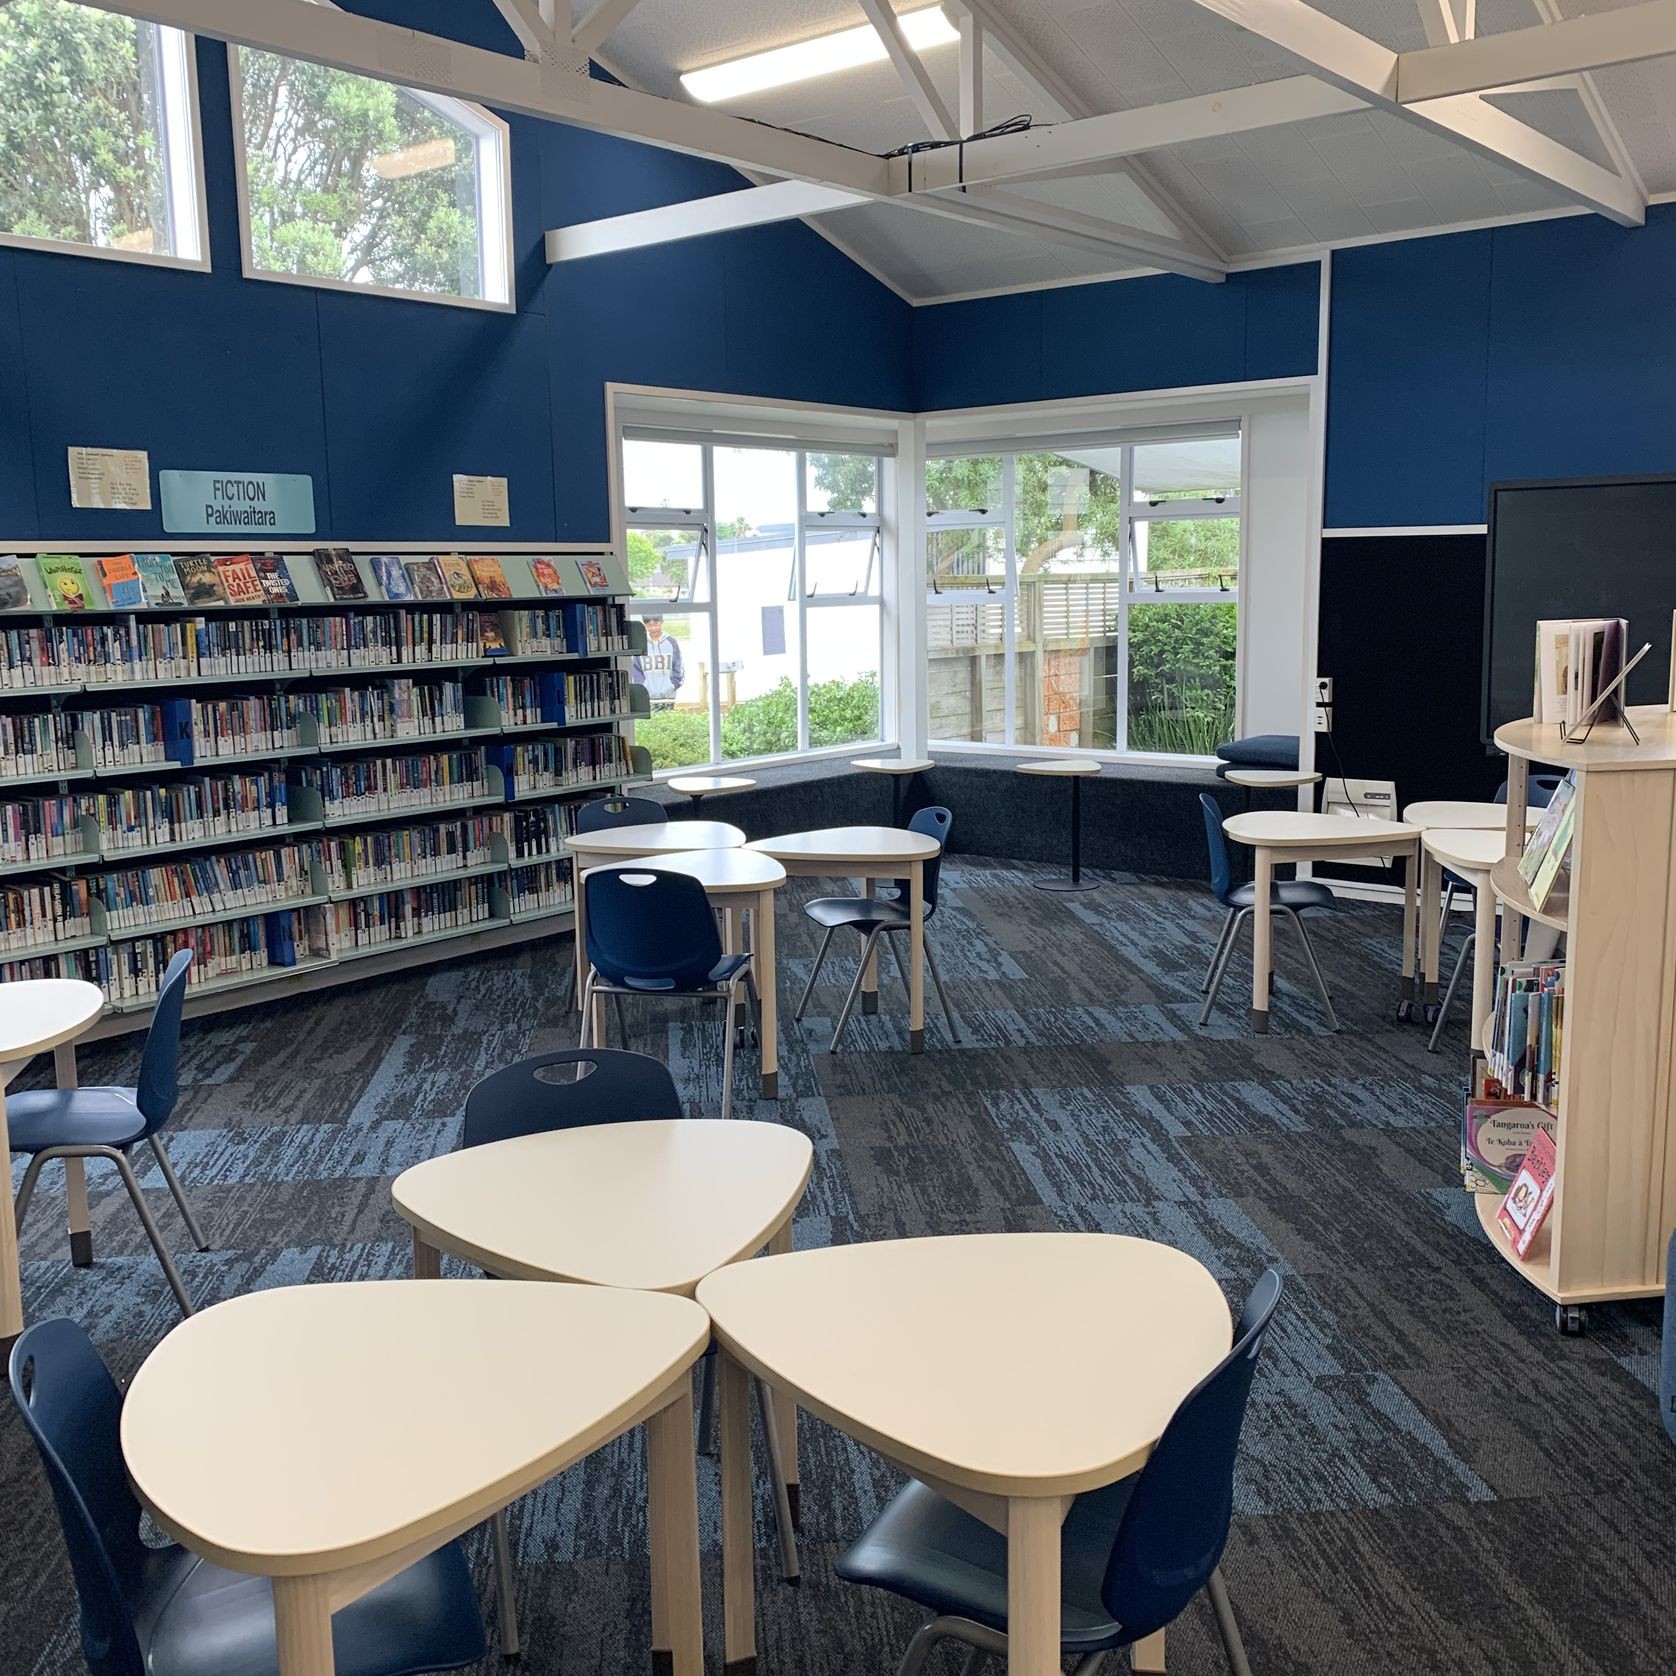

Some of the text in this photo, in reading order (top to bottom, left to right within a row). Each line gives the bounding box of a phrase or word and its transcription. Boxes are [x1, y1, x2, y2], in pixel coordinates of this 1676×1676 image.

[213, 479, 266, 501] FICTION
[205, 504, 276, 526] Pakiwaitara
[180, 558, 208, 569] TURTLE
[184, 565, 208, 575] MOON
[222, 566, 257, 583] FAIL
[266, 572, 280, 581] THE
[227, 580, 262, 597] SAFE
[261, 579, 290, 587] TWISTED
[268, 586, 287, 594] ONES
[178, 720, 191, 740] K
[1490, 1120, 1553, 1131] Tangaroa's Gift
[1497, 1138, 1516, 1147] Koha
